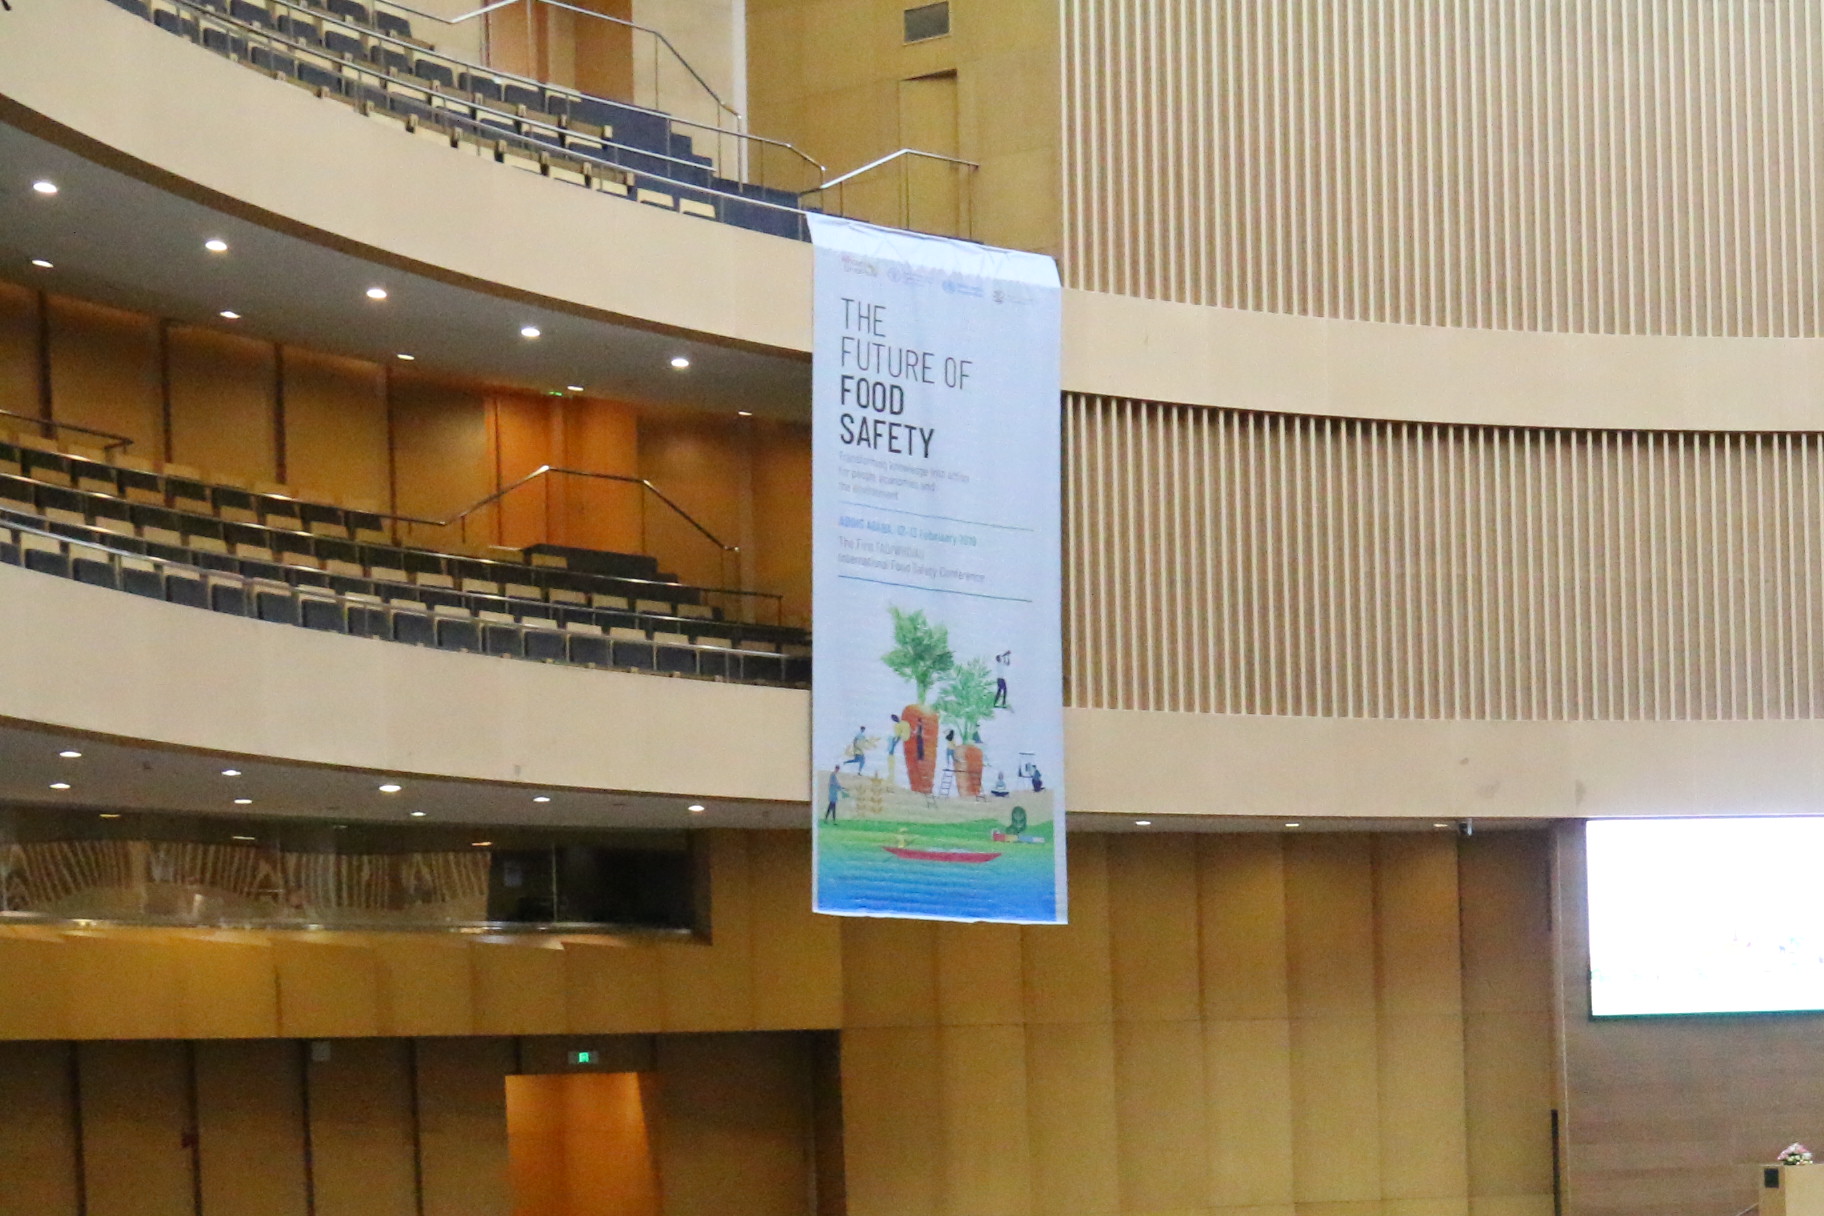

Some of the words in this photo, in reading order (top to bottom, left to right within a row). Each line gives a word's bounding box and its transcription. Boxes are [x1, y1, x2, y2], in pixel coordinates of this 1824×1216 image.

[841, 297, 887, 338] THE
[841, 336, 935, 384] FUTURE
[944, 356, 973, 390] OF
[840, 374, 904, 416] FOOD
[840, 413, 935, 459] SAFETY
